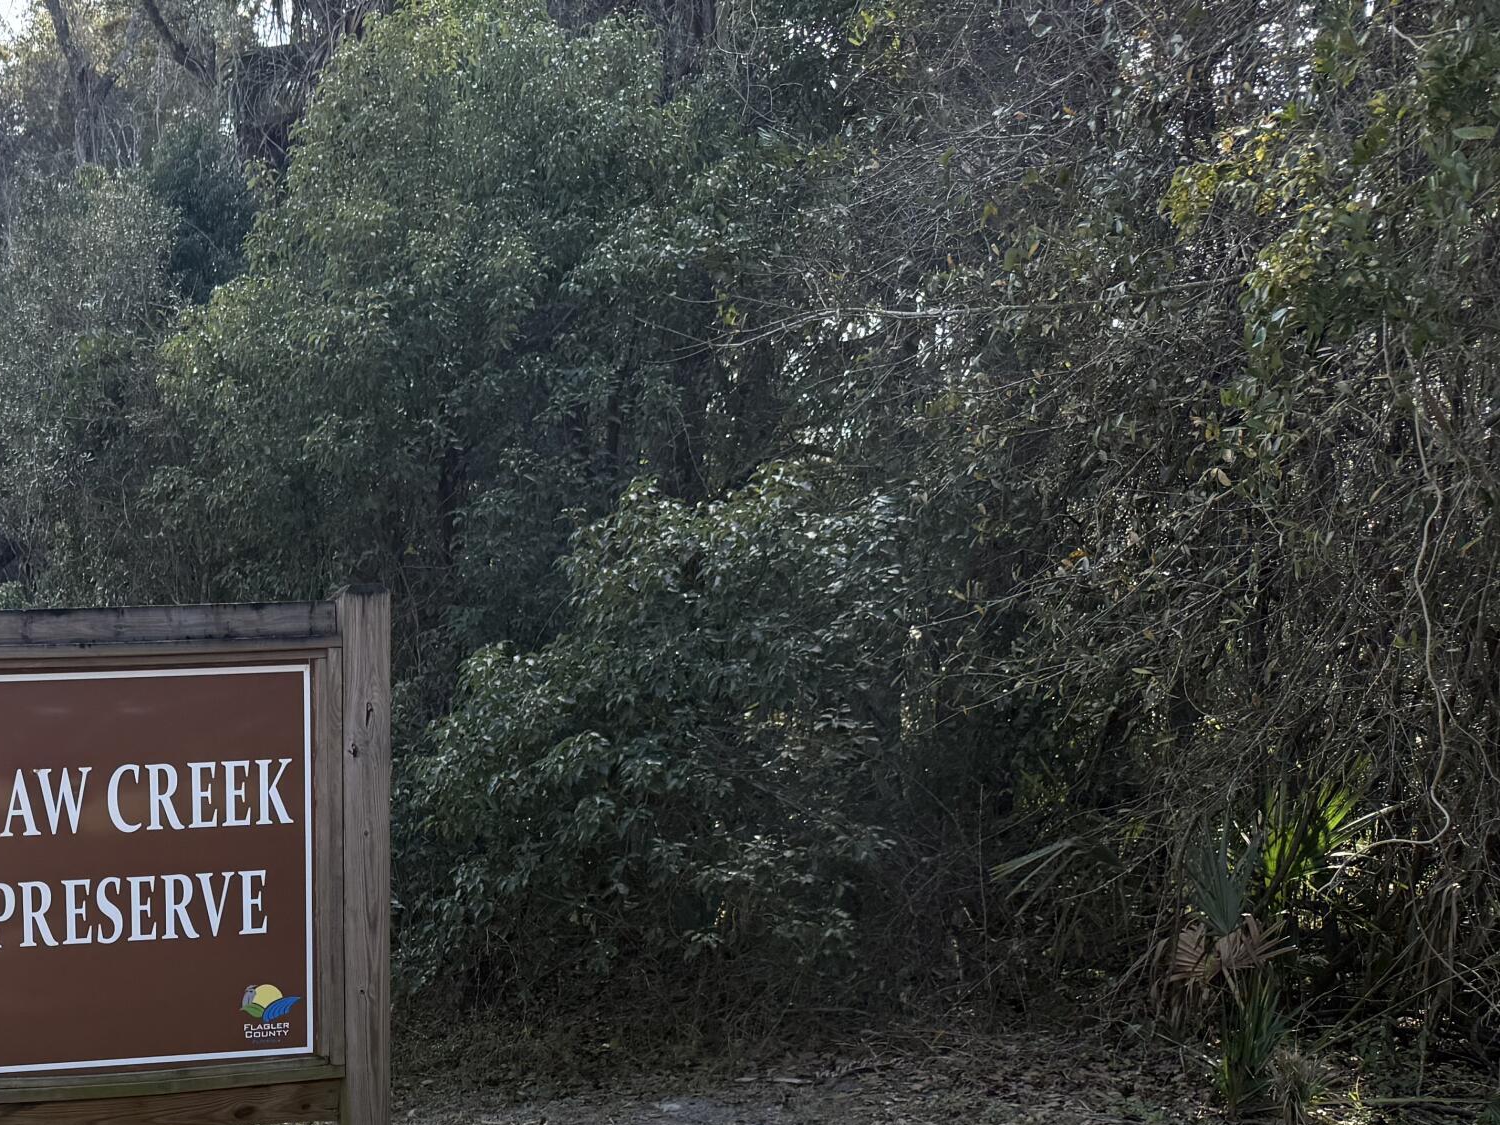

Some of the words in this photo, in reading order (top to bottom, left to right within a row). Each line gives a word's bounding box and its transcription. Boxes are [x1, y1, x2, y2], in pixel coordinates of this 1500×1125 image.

[106, 758, 294, 833] CREEK
[243, 1022, 290, 1032] FLAGLER
[245, 1029, 290, 1039] COUNTY
